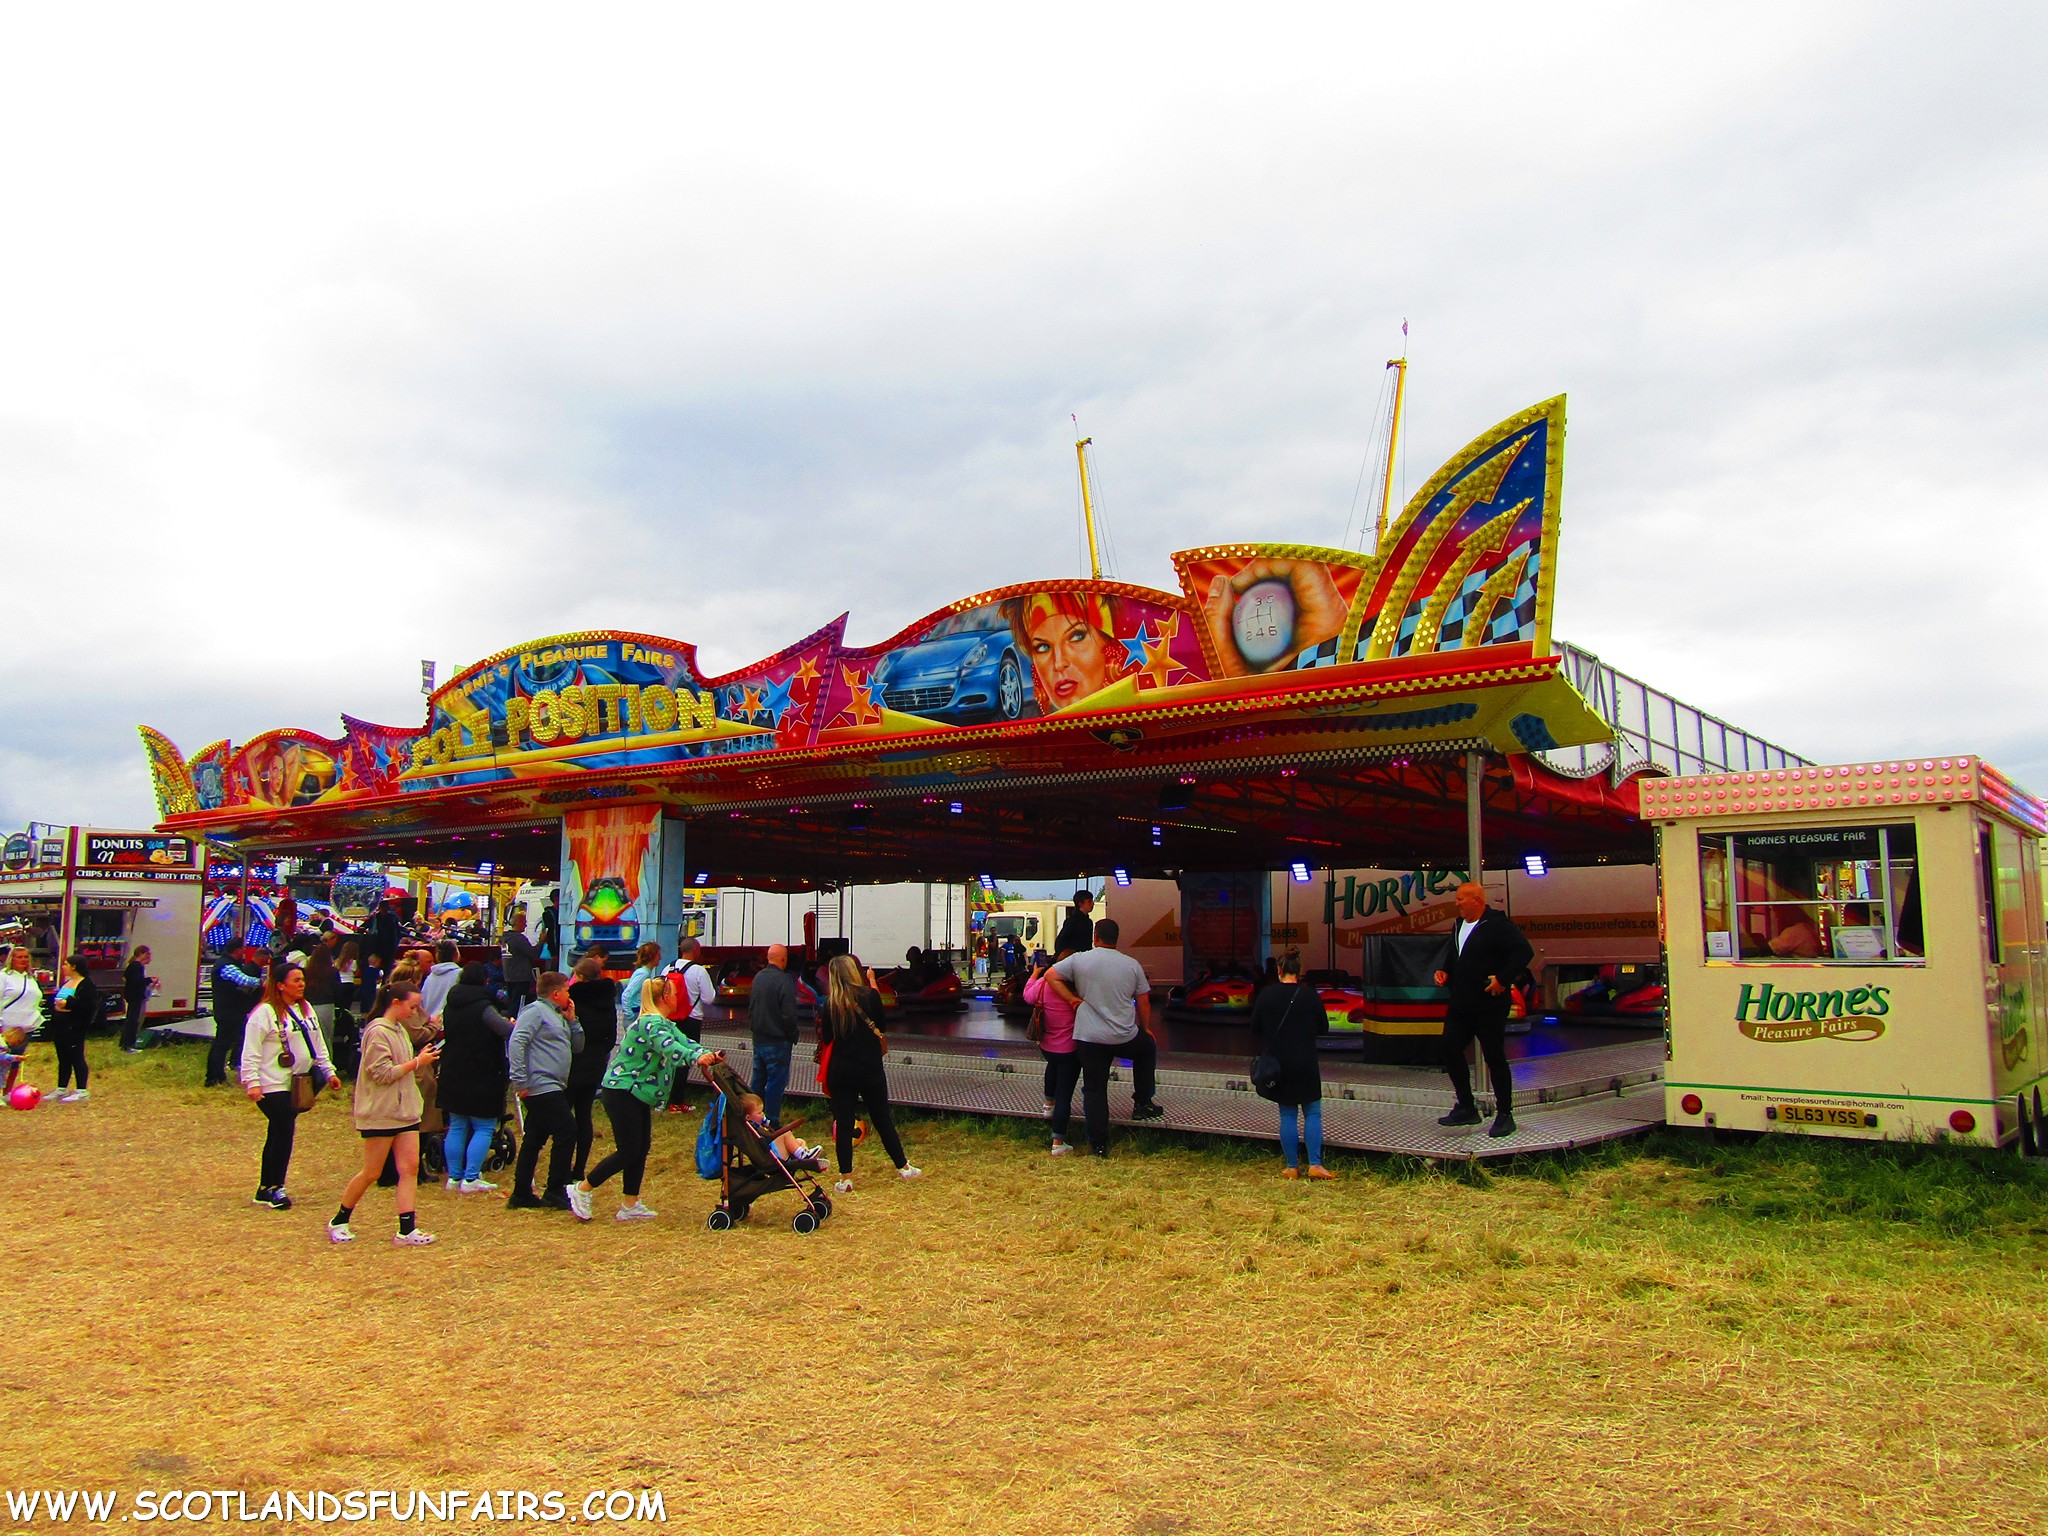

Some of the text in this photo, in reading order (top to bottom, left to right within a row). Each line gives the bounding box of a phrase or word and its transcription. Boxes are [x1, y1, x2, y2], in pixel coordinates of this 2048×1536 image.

[1256, 595, 1275, 607] 3 5
[1246, 625, 1278, 641] 2 4 6
[519, 644, 608, 671] PLEASURE
[622, 643, 676, 669] FAIRS
[411, 683, 719, 774] POLE POSITION
[92, 839, 144, 849] DONUTS
[1747, 831, 1866, 846] HORNES PLEASURE FAIR
[155, 872, 178, 880] DIRTY
[1409, 907, 1446, 929] Fairs
[1753, 1018, 1858, 1039] Pleasure Fairs
[1740, 1093, 1905, 1110] Email: hornespleasurefairs@hotmail.com
[1785, 1107, 1858, 1125] SL63 YSS
